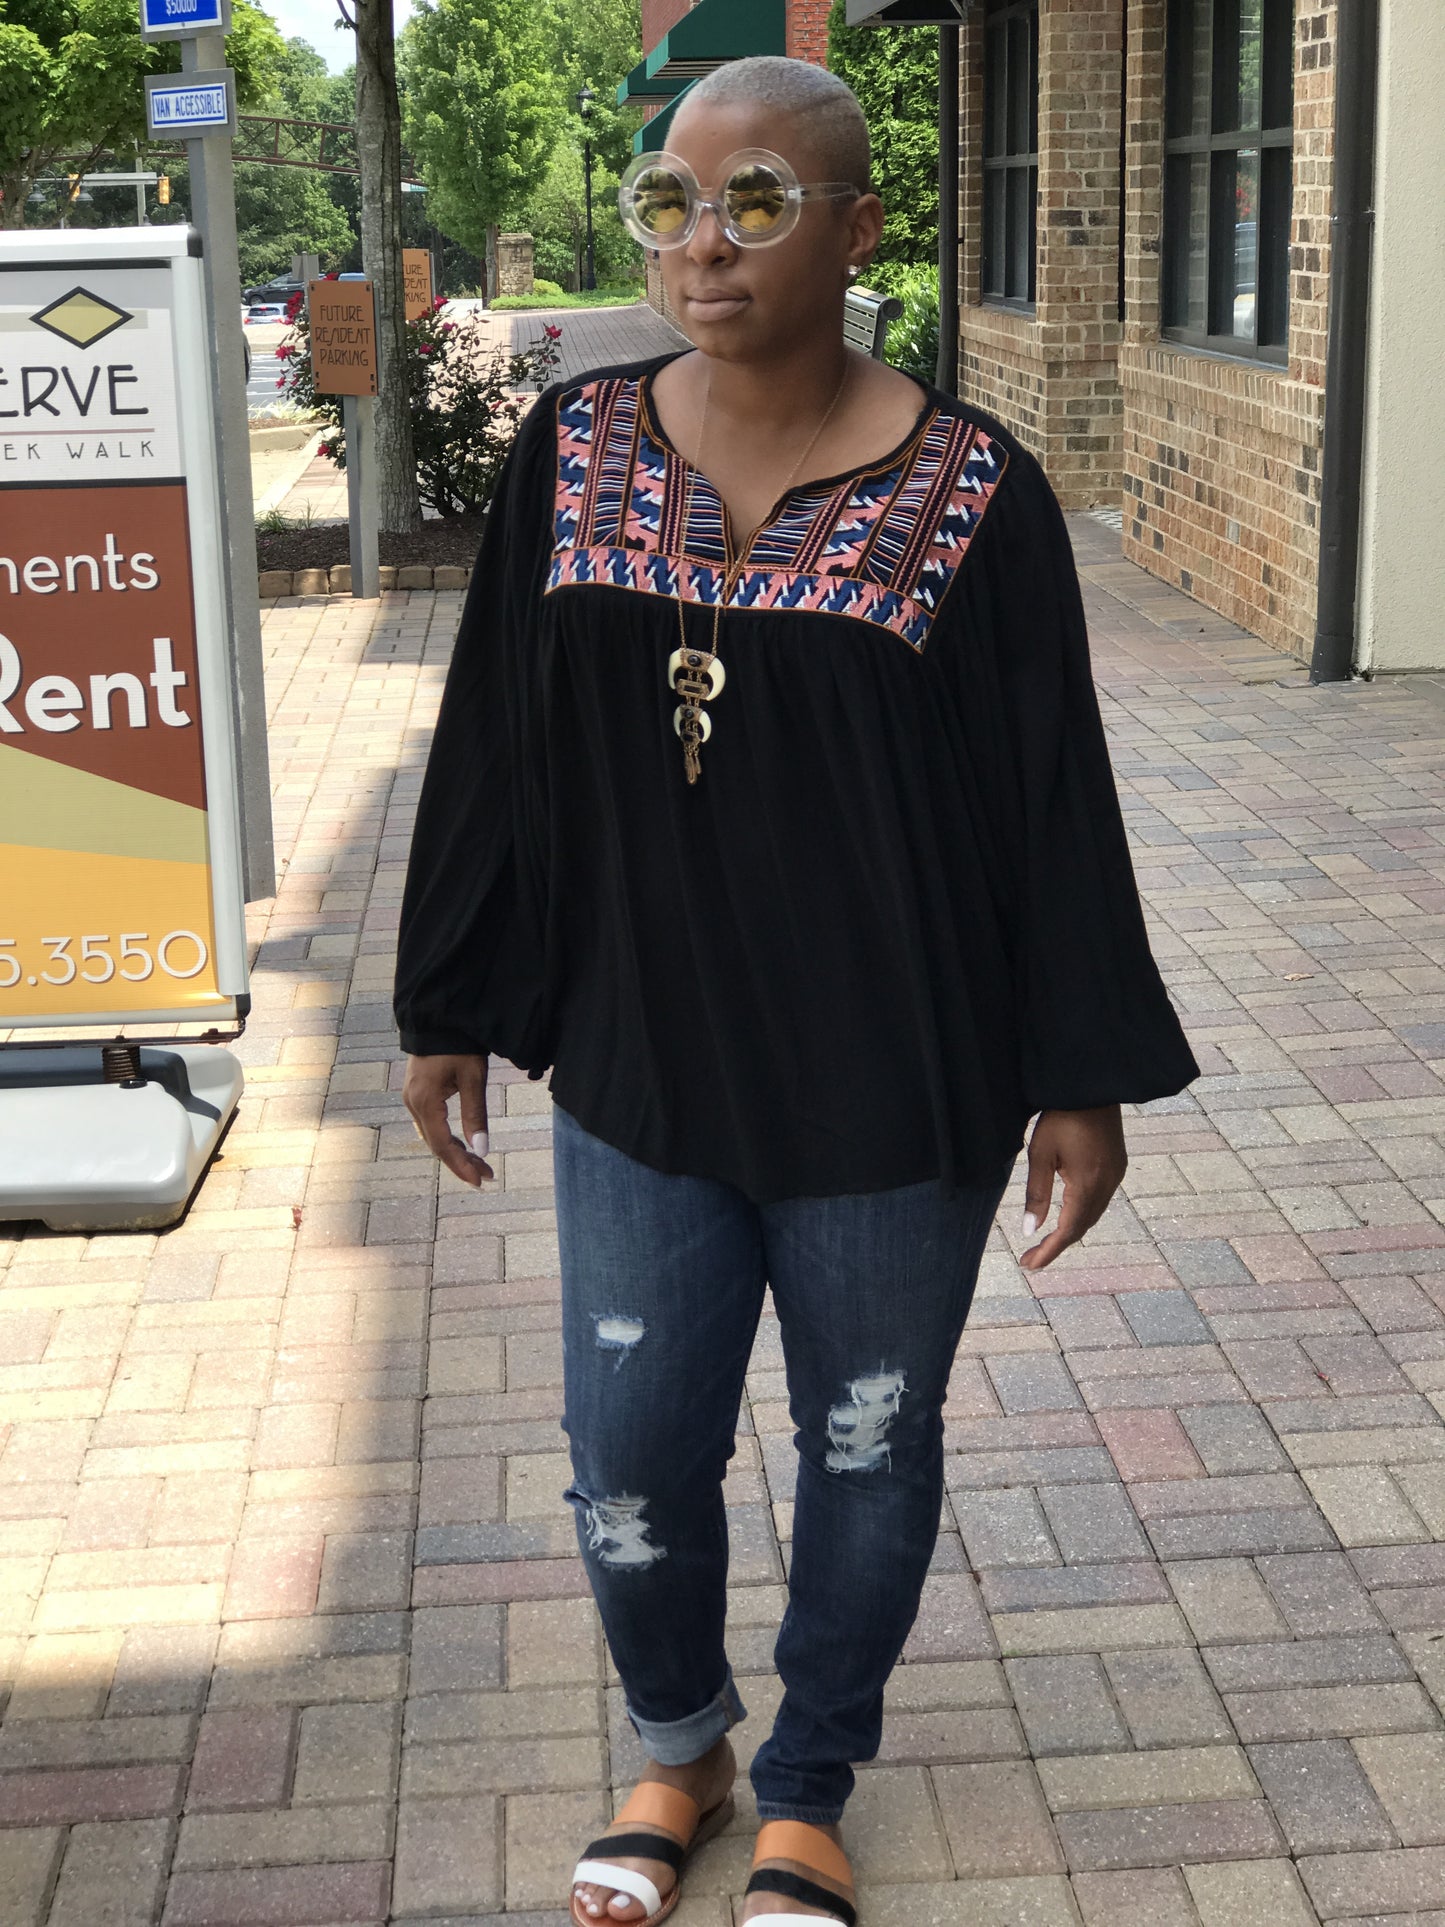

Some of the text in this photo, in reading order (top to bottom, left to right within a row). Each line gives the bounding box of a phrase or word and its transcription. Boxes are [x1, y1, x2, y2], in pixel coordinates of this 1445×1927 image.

[155, 93, 222, 118] VAN ACCESSIBLE
[403, 264, 424, 275] URE
[320, 305, 364, 322] FUTURE
[315, 327, 371, 346] RESIDENT
[320, 348, 369, 366] PARKING
[66, 441, 154, 459] WALK
